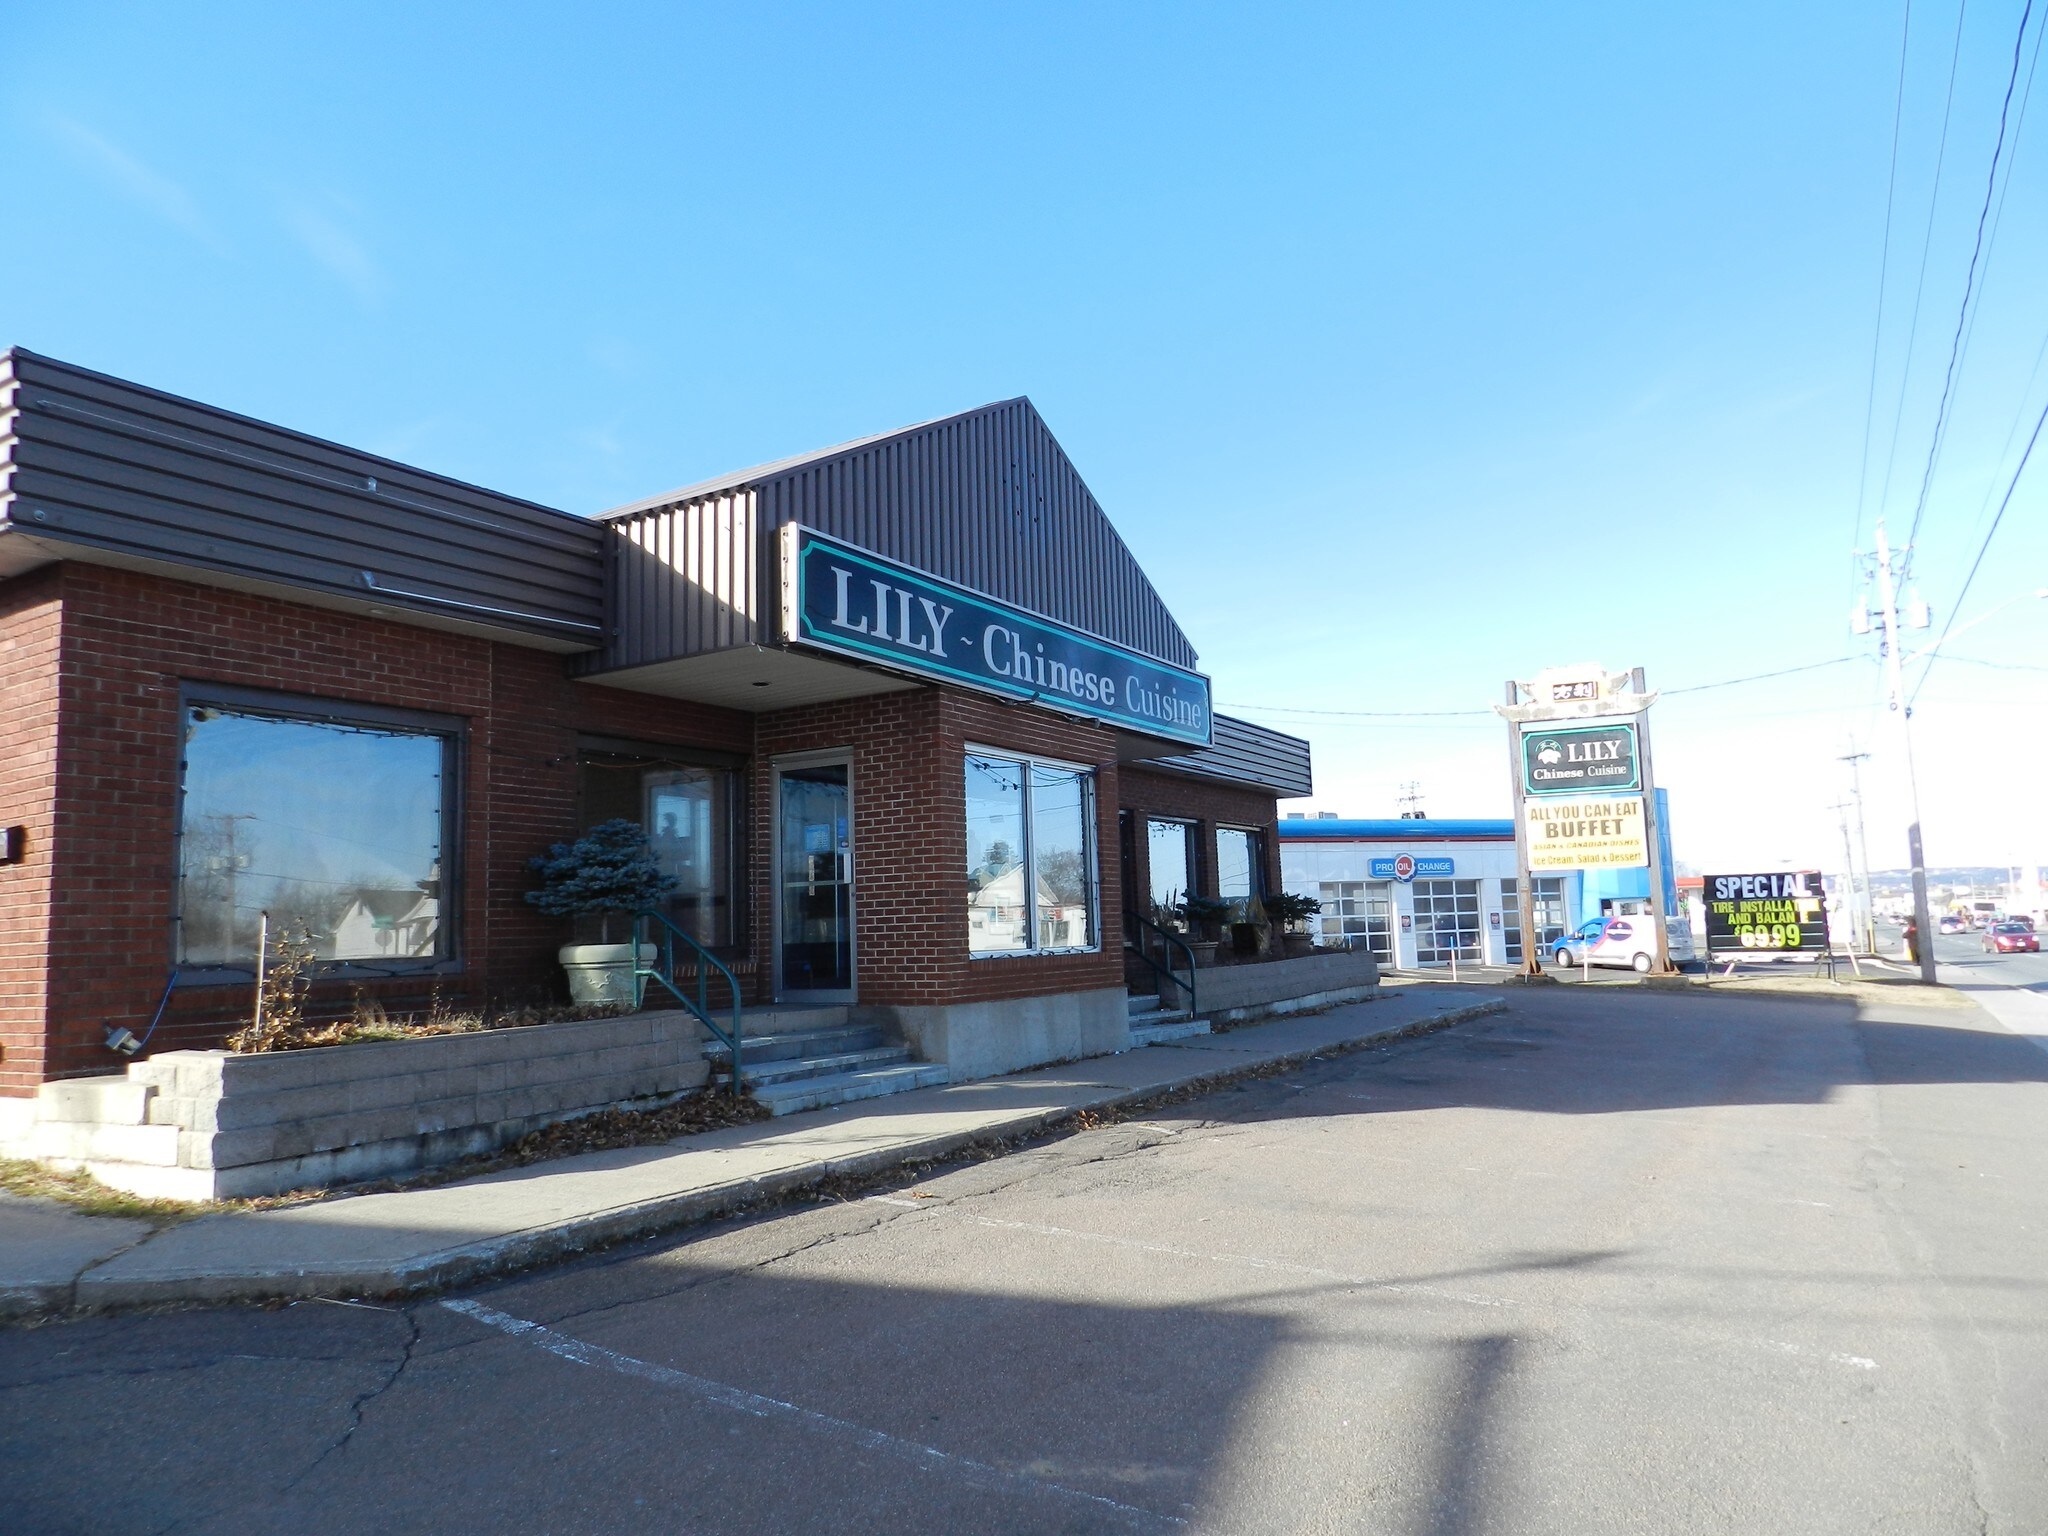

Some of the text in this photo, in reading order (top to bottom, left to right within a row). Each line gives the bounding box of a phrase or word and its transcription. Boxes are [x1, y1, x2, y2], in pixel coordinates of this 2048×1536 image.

[831, 566, 954, 658] LILY
[983, 624, 1115, 705] Chinese
[1125, 676, 1201, 729] Cuisine
[1567, 740, 1621, 762] LILY
[1533, 764, 1626, 780] Chinese Cuisine
[1531, 802, 1638, 821] ALL YOU CAN EAT
[1545, 818, 1624, 838] BUFFET
[1567, 841, 1608, 849] CANADIAN
[1610, 839, 1640, 847] DISHES
[1375, 862, 1451, 871] PRO OIL CHANGE
[1534, 856, 1546, 865] Ice
[1577, 854, 1600, 864] Salad
[1609, 852, 1641, 862] Dessert
[1715, 873, 1813, 899] SPECIAL
[1712, 899, 1821, 913] TIRE INSTALLAT
[1728, 913, 1751, 925] AND
